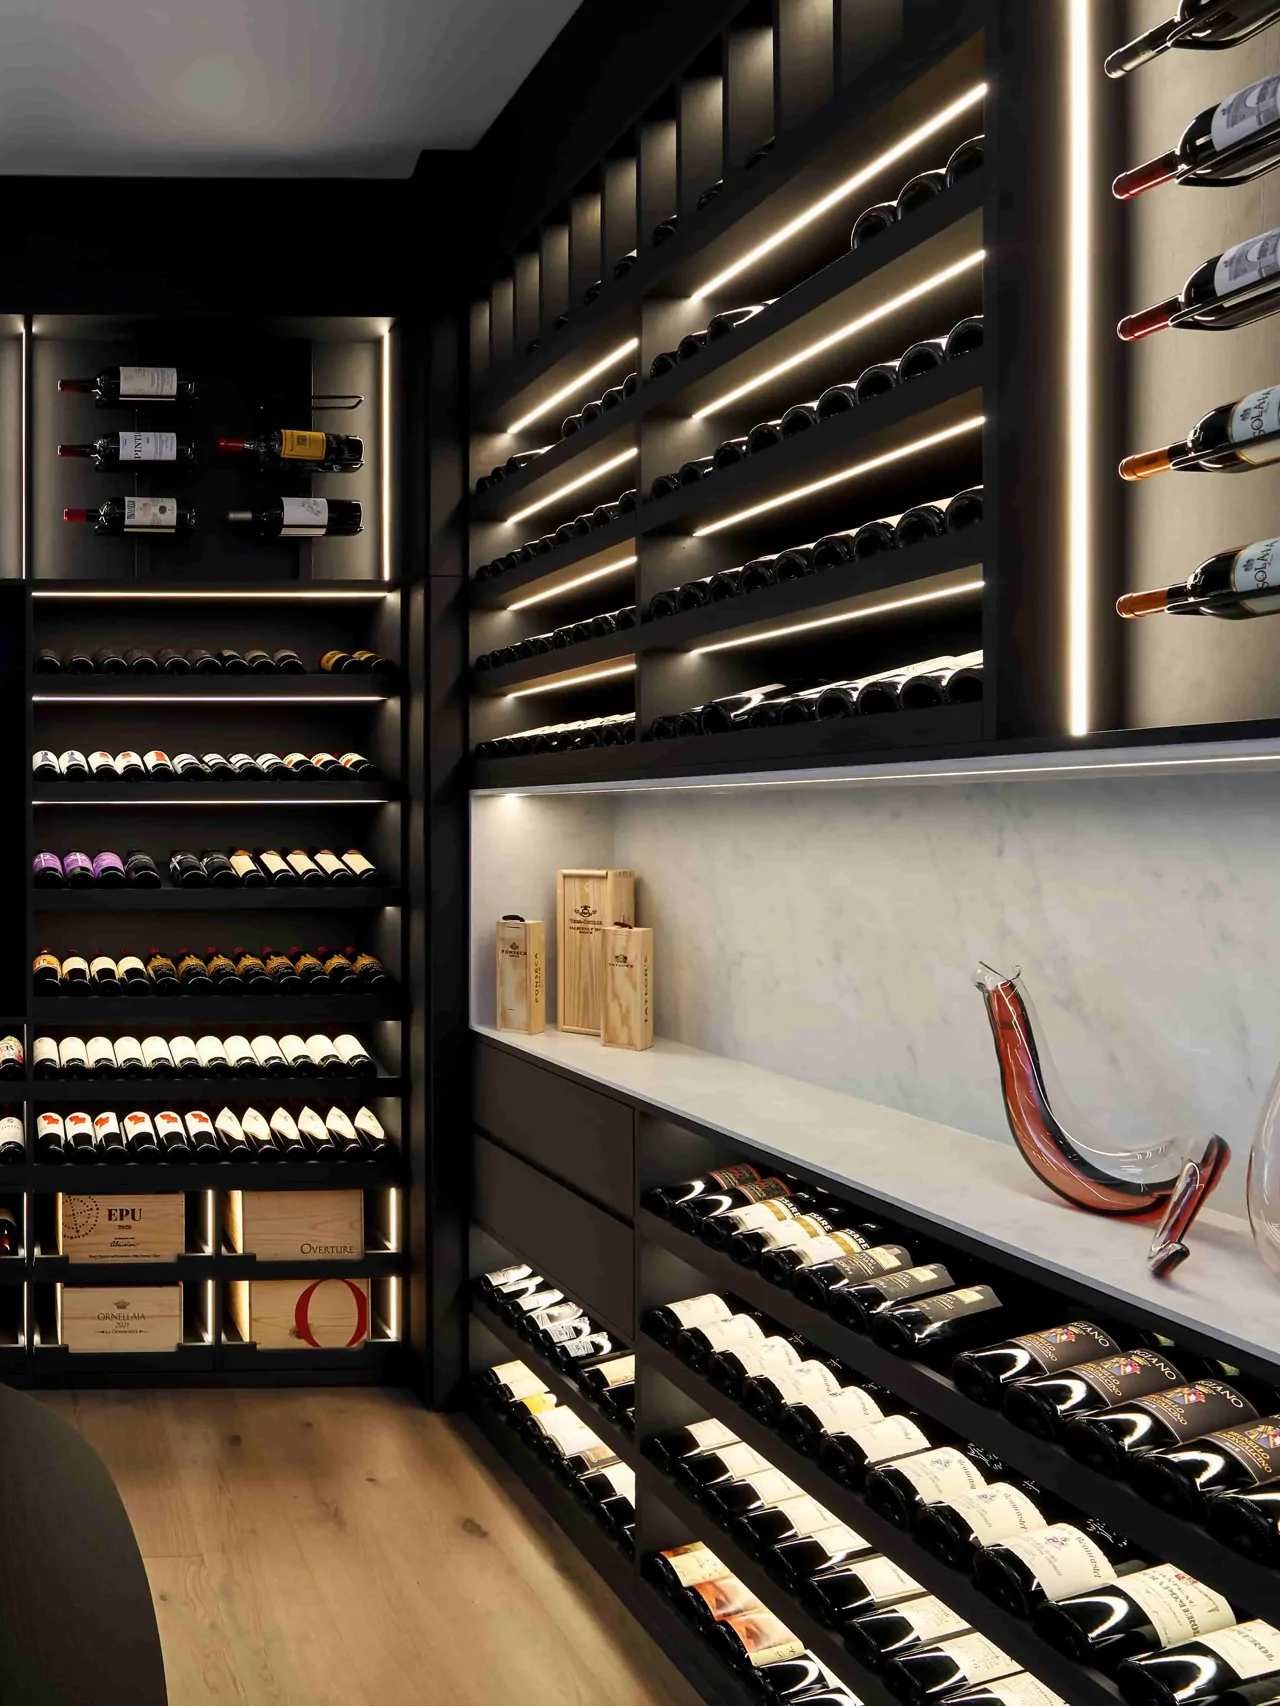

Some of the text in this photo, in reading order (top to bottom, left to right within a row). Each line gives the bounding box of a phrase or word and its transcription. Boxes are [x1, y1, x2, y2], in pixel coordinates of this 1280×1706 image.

[1253, 539, 1279, 589] SOLAIA
[107, 1208, 142, 1222] EPU
[300, 1243, 354, 1255] OVERTURE
[97, 1312, 146, 1321] ORNELLAIA
[1071, 1322, 1110, 1347] GIANO
[1220, 1432, 1273, 1473] MONTALCINO
[1227, 1431, 1270, 1459] BRUNELLO
